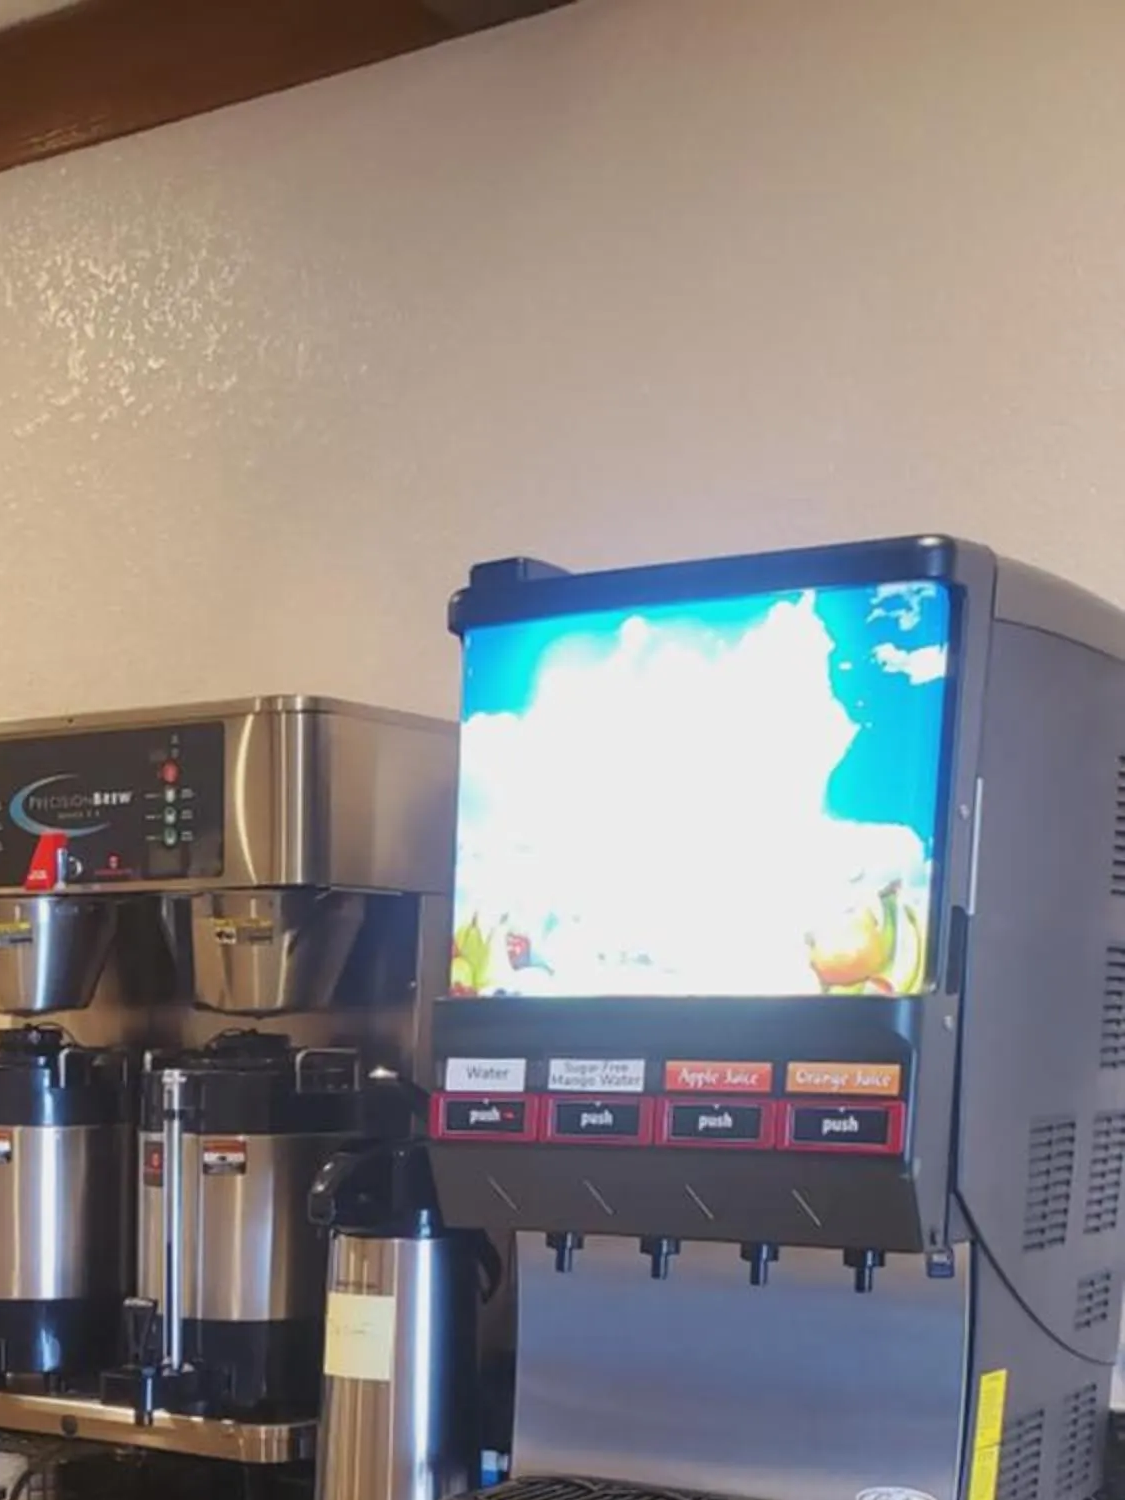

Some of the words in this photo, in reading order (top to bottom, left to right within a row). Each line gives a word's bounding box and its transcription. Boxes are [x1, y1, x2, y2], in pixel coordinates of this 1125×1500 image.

[466, 1066, 509, 1080] Water
[551, 1074, 596, 1087] Mango
[600, 1074, 642, 1087] Water
[677, 1066, 717, 1088] Apple
[724, 1068, 759, 1085] Juice
[794, 1069, 850, 1091] Orange
[854, 1070, 892, 1087] Juice
[469, 1107, 500, 1124] push
[580, 1109, 613, 1128] push
[698, 1112, 733, 1130] push
[822, 1116, 858, 1134] push
